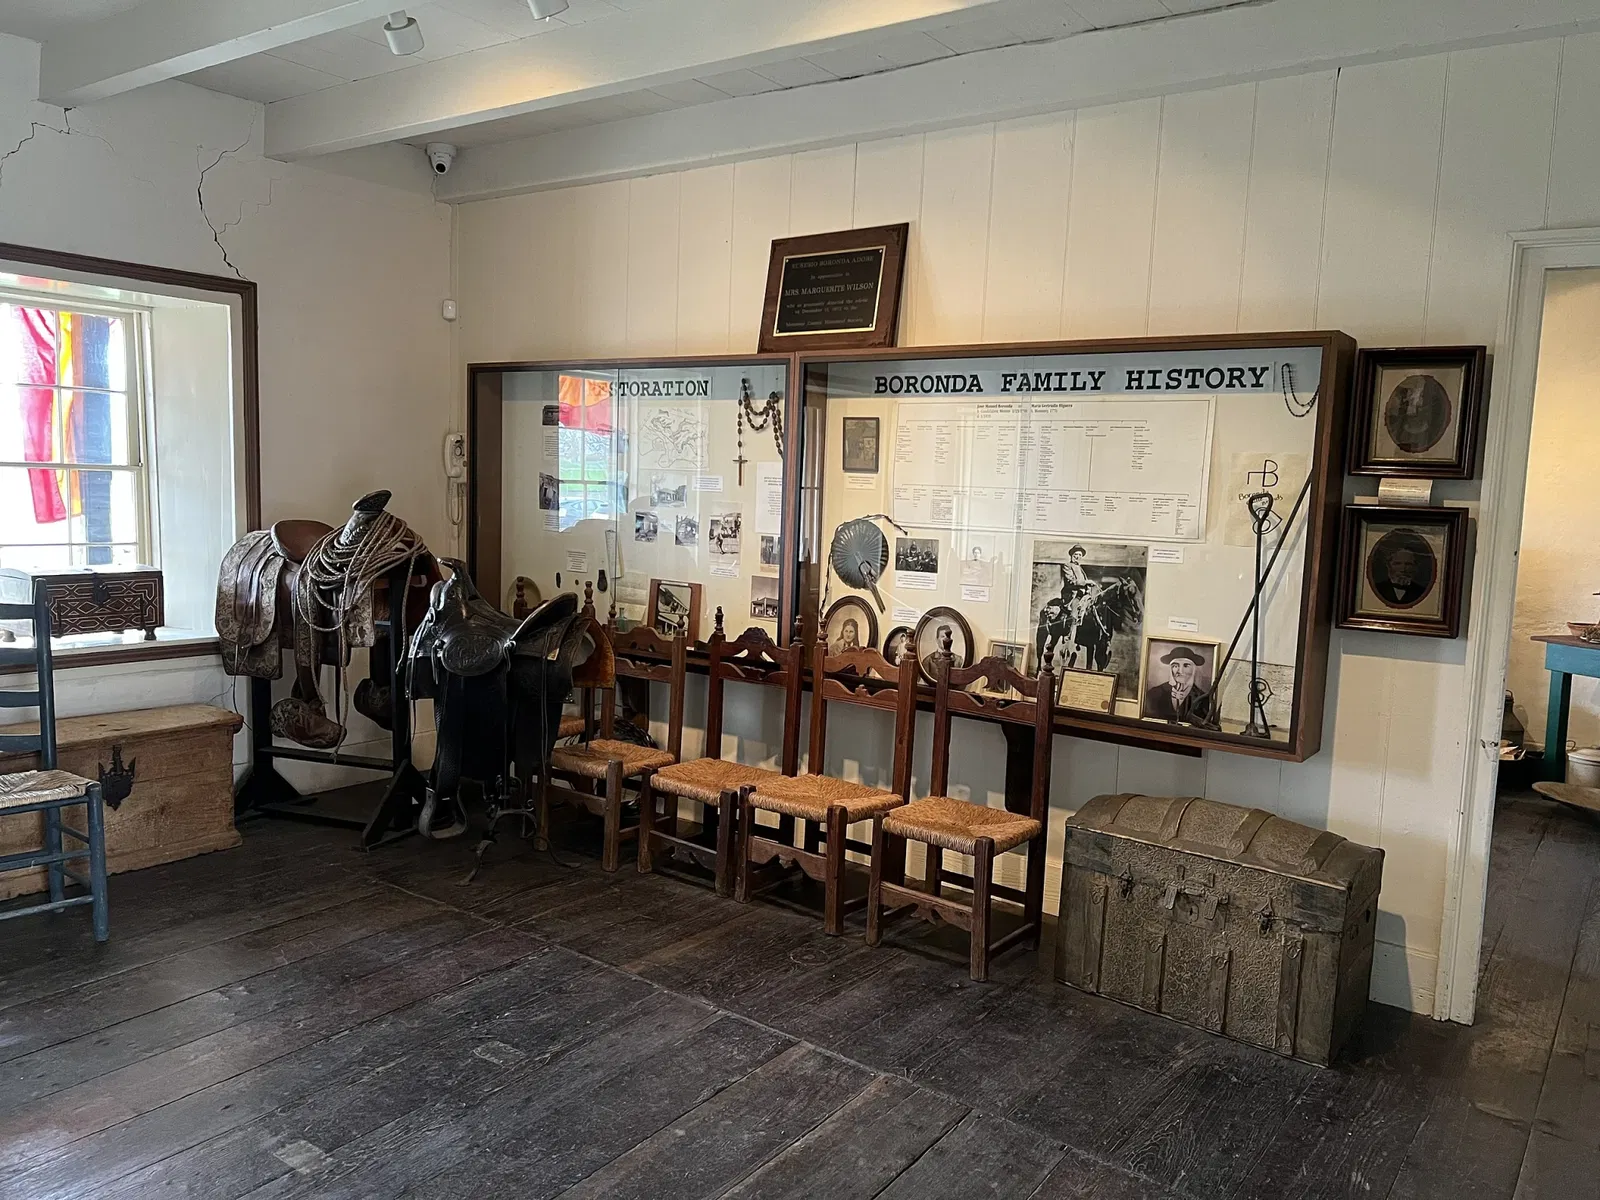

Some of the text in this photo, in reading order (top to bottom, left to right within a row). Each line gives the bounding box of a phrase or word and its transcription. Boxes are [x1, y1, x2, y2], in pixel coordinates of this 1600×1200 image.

[819, 257, 851, 267] BORONDA
[800, 284, 845, 296] MARGUERITE
[846, 282, 874, 291] WILSON
[874, 366, 1270, 394] BORONDA FAMILY HISTORY
[588, 380, 709, 397] STORATION
